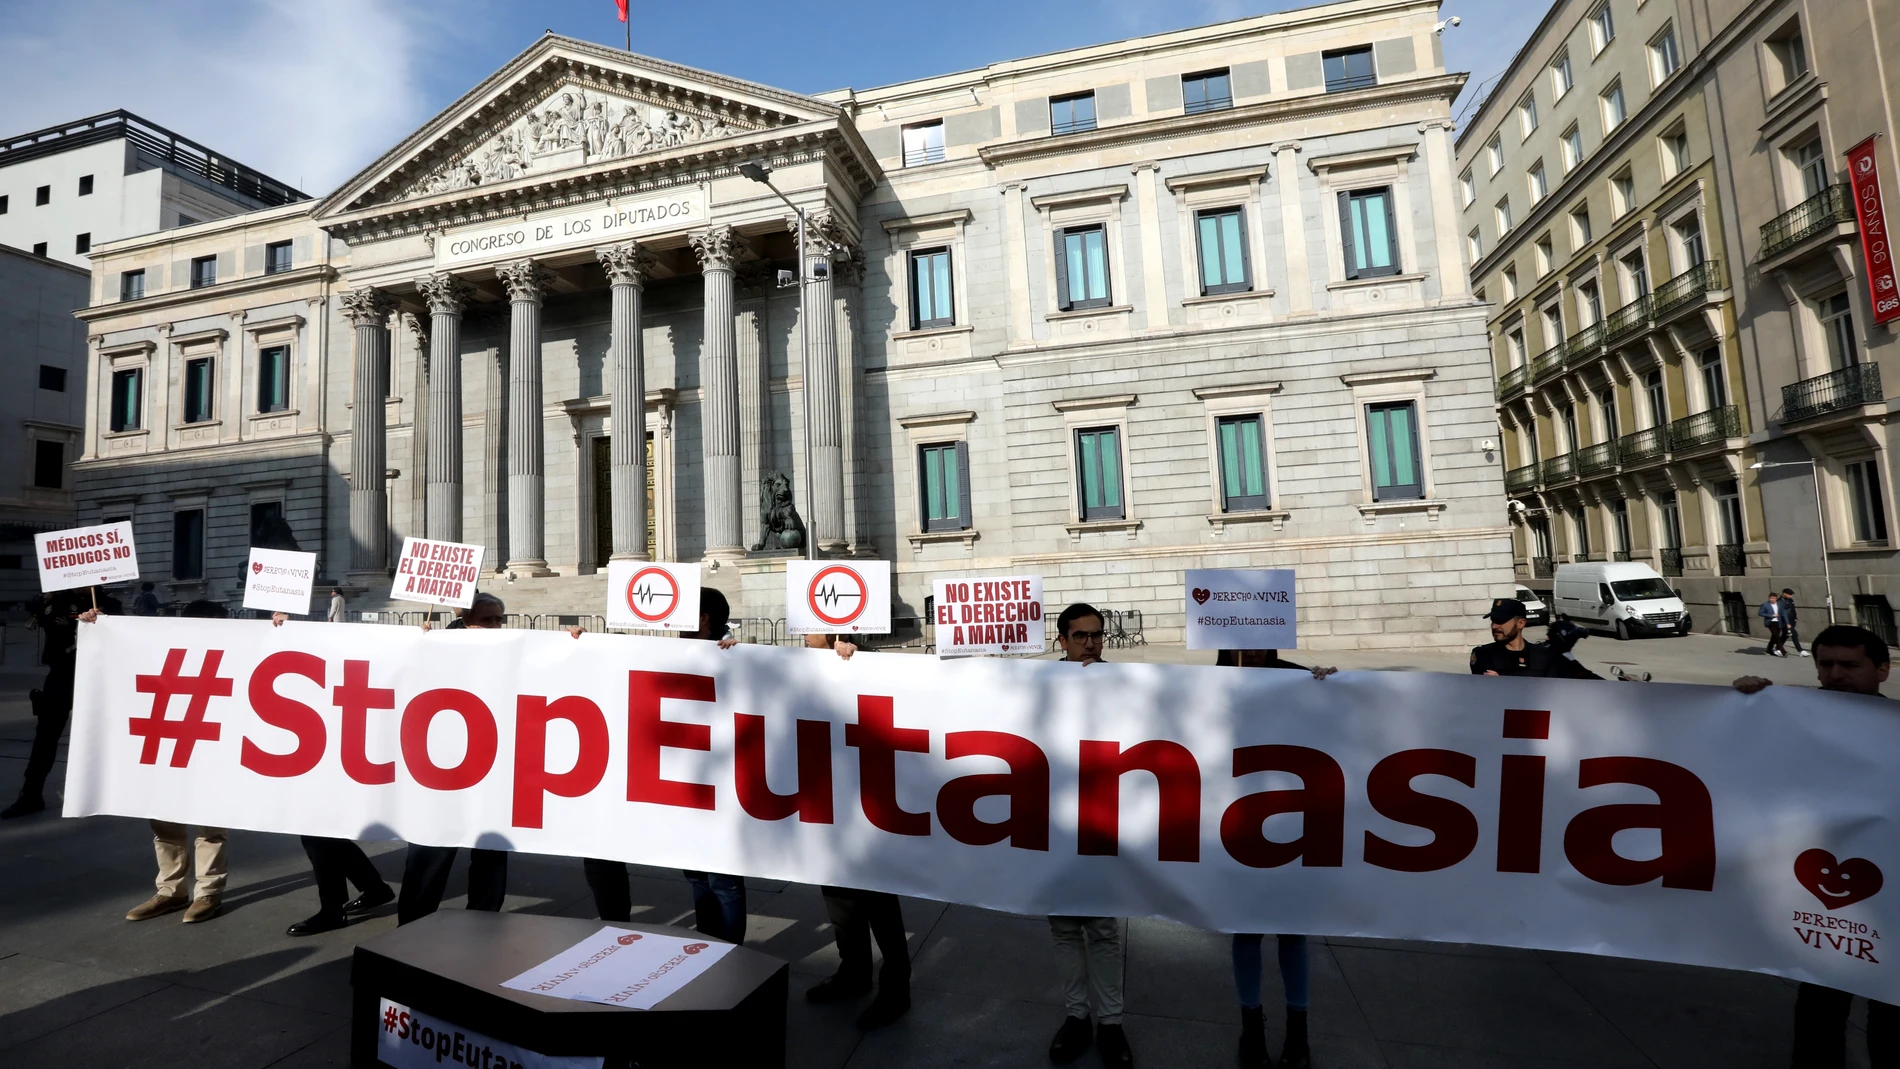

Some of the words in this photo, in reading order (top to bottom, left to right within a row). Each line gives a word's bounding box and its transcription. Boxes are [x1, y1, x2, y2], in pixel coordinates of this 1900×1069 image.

[1861, 184, 1882, 235] AÑOS
[451, 230, 525, 256] CONGRESO
[536, 225, 554, 242] DE
[563, 219, 592, 236] LOS
[602, 200, 691, 230] DIPUTADOS
[1871, 240, 1886, 264] 90
[46, 534, 104, 553] MÉDICOS
[106, 528, 123, 544] SÍ,
[43, 549, 111, 570] VERDUGOS
[113, 546, 130, 559] NO
[411, 542, 429, 558] NO
[431, 545, 475, 564] EXISTE
[63, 566, 117, 578] #StopEutanasia
[264, 566, 287, 575] DERECHO
[290, 569, 309, 579] VIVIR
[399, 558, 413, 574] EL
[417, 560, 477, 582] DERECHO
[252, 584, 304, 596] #StopEutanasia
[405, 576, 415, 592] A
[417, 578, 462, 598] MATAR
[945, 583, 969, 603] NO
[973, 580, 1031, 602] EXISTE
[1212, 592, 1251, 602] DERECHO
[1257, 590, 1289, 602] VIVIR
[937, 605, 957, 625] EL
[961, 601, 1041, 624] DERECHO
[1197, 616, 1286, 627] #StopEutanasia
[953, 625, 964, 645] A
[968, 623, 1028, 645] MATAR
[128, 648, 1716, 891] #StopEutanasia
[1792, 911, 1868, 934] DERECHO
[1871, 930, 1881, 939] A
[578, 945, 621, 968] DERECHO
[1793, 926, 1880, 964] VIVIR
[648, 954, 689, 979] DERECHO
[530, 971, 579, 991] VIVIR
[604, 982, 650, 1002] VIVIR
